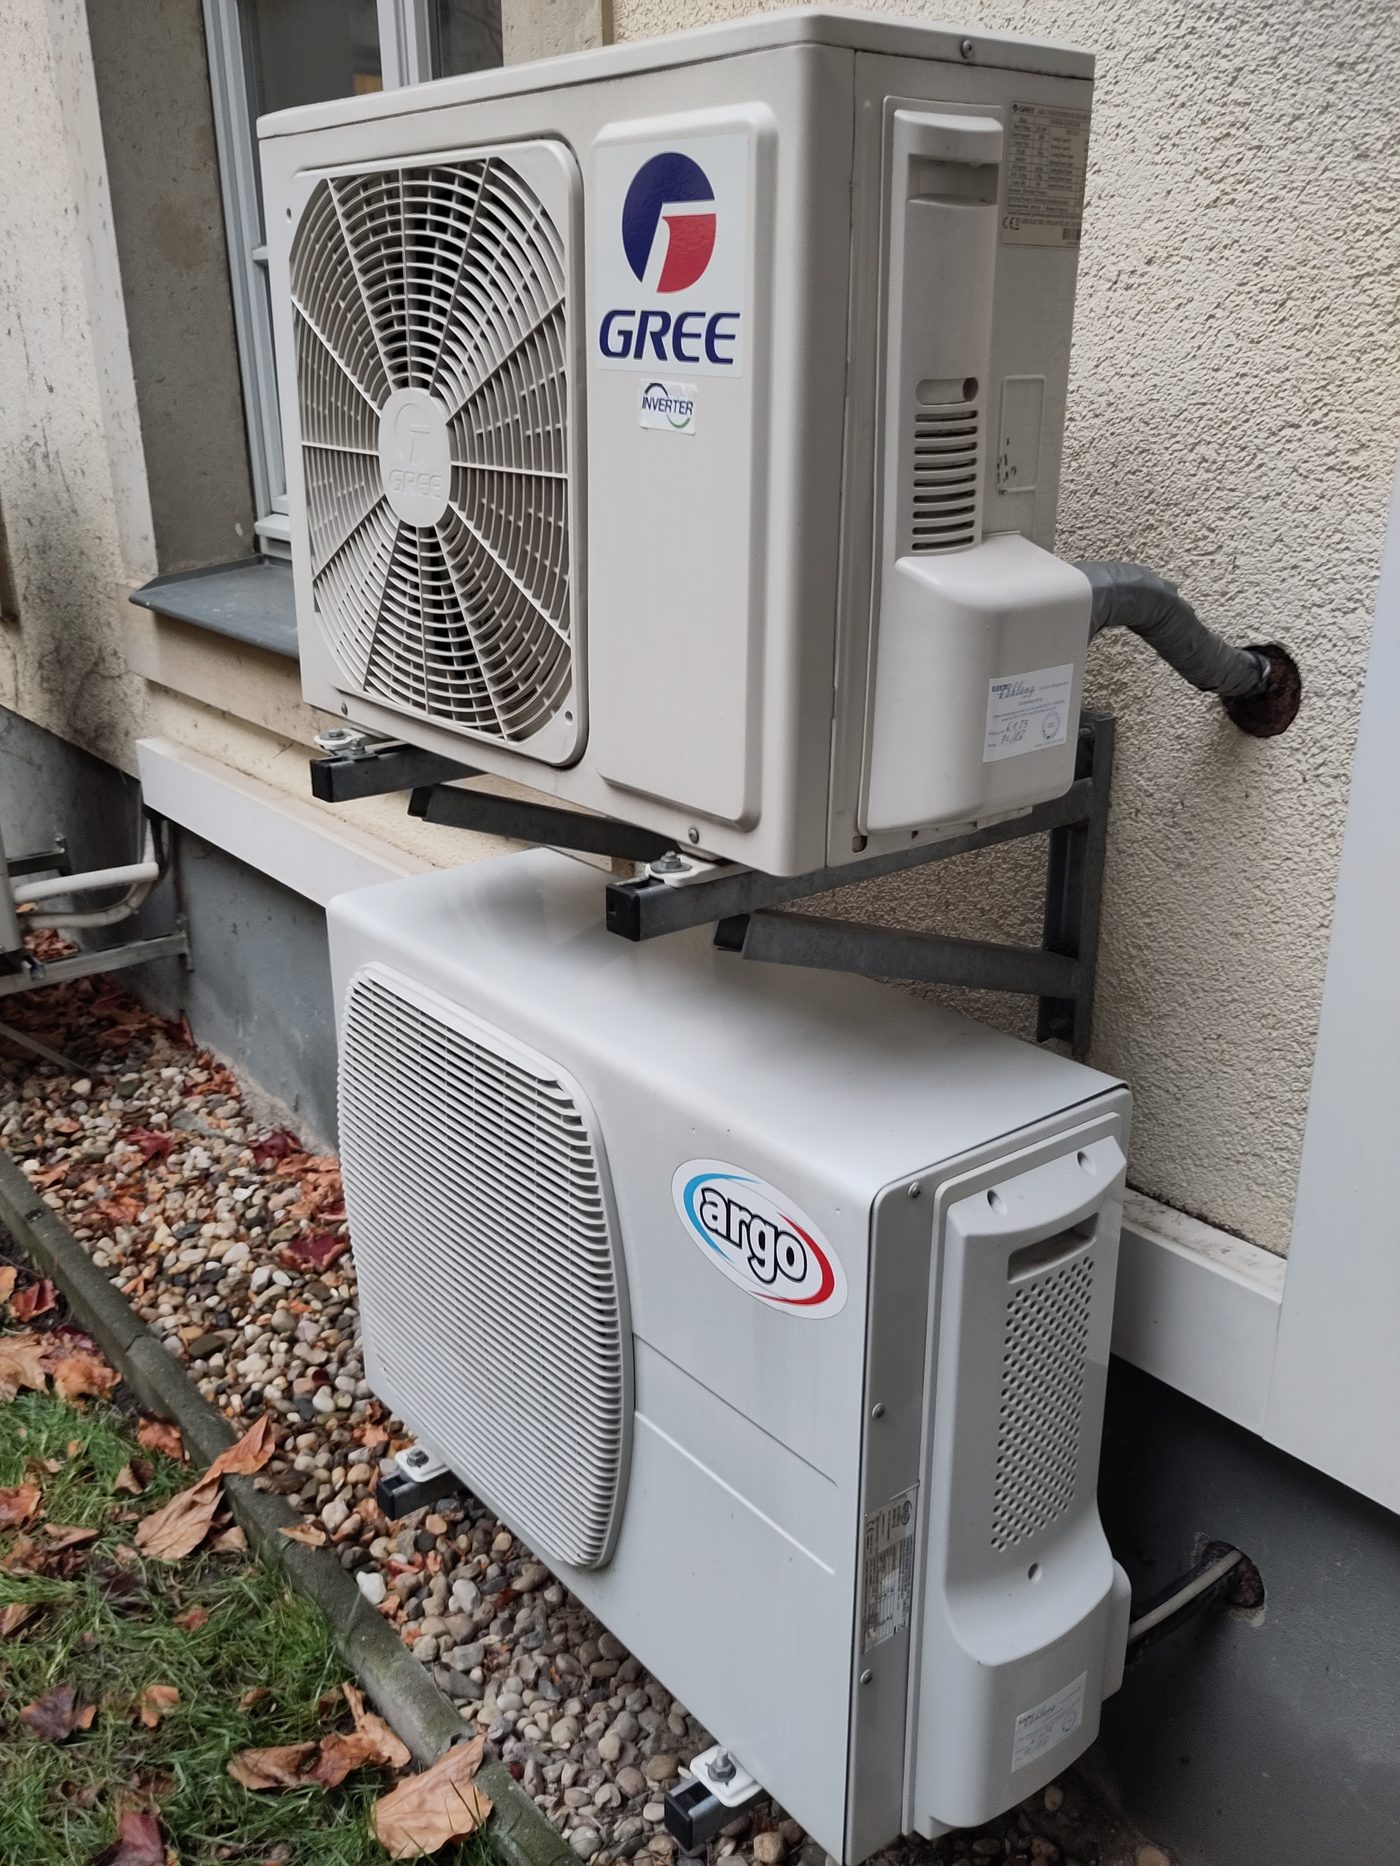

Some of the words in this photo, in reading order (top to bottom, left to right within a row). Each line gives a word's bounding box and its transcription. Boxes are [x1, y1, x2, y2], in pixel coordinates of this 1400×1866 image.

[599, 310, 740, 364] GREE
[641, 395, 694, 416] INVERTER
[389, 469, 442, 499] GREE
[700, 1187, 808, 1285] argo
